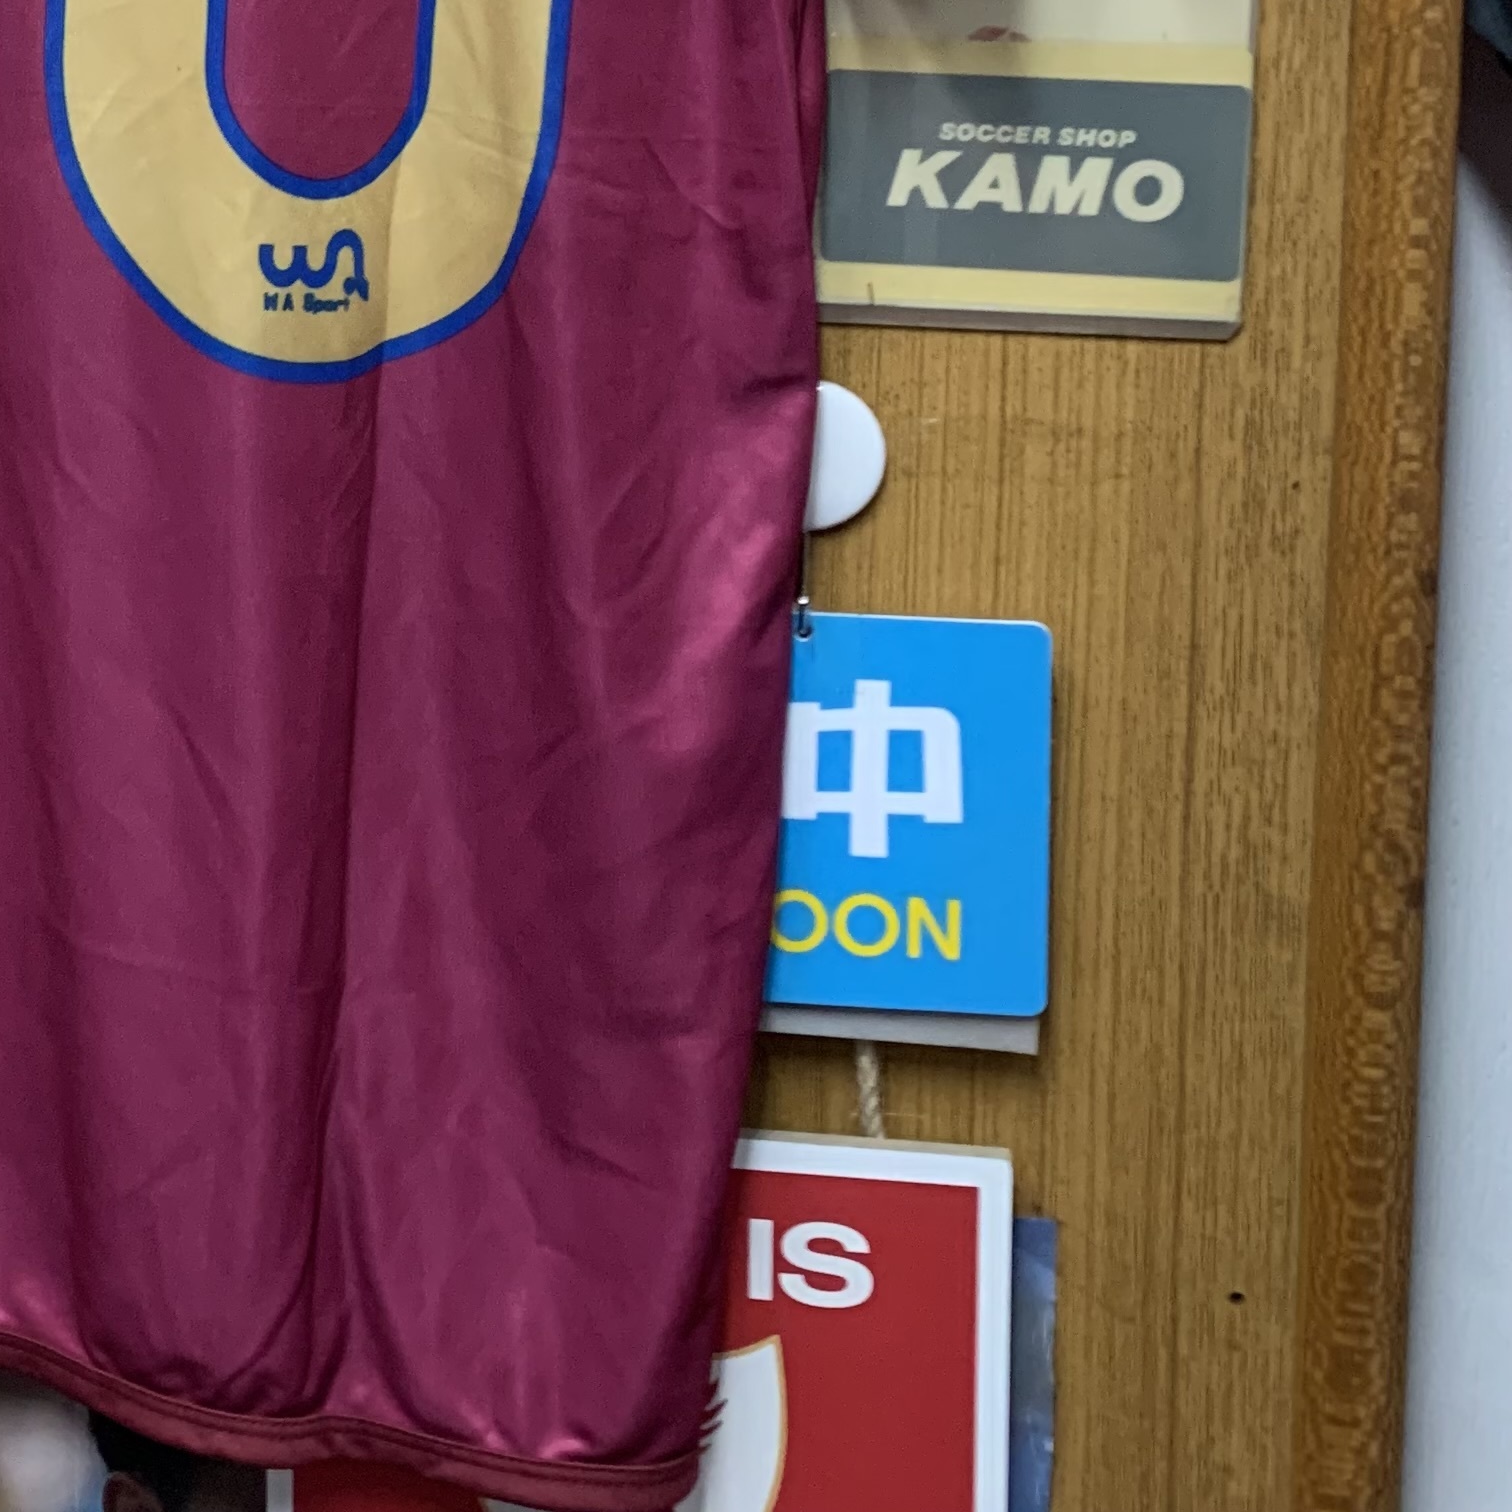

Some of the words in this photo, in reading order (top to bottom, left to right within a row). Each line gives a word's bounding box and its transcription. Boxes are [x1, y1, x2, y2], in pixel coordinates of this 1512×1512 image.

[939, 122, 1050, 145] SOCCER
[1058, 126, 1137, 148] SHOP
[886, 147, 1185, 223] KAMO
